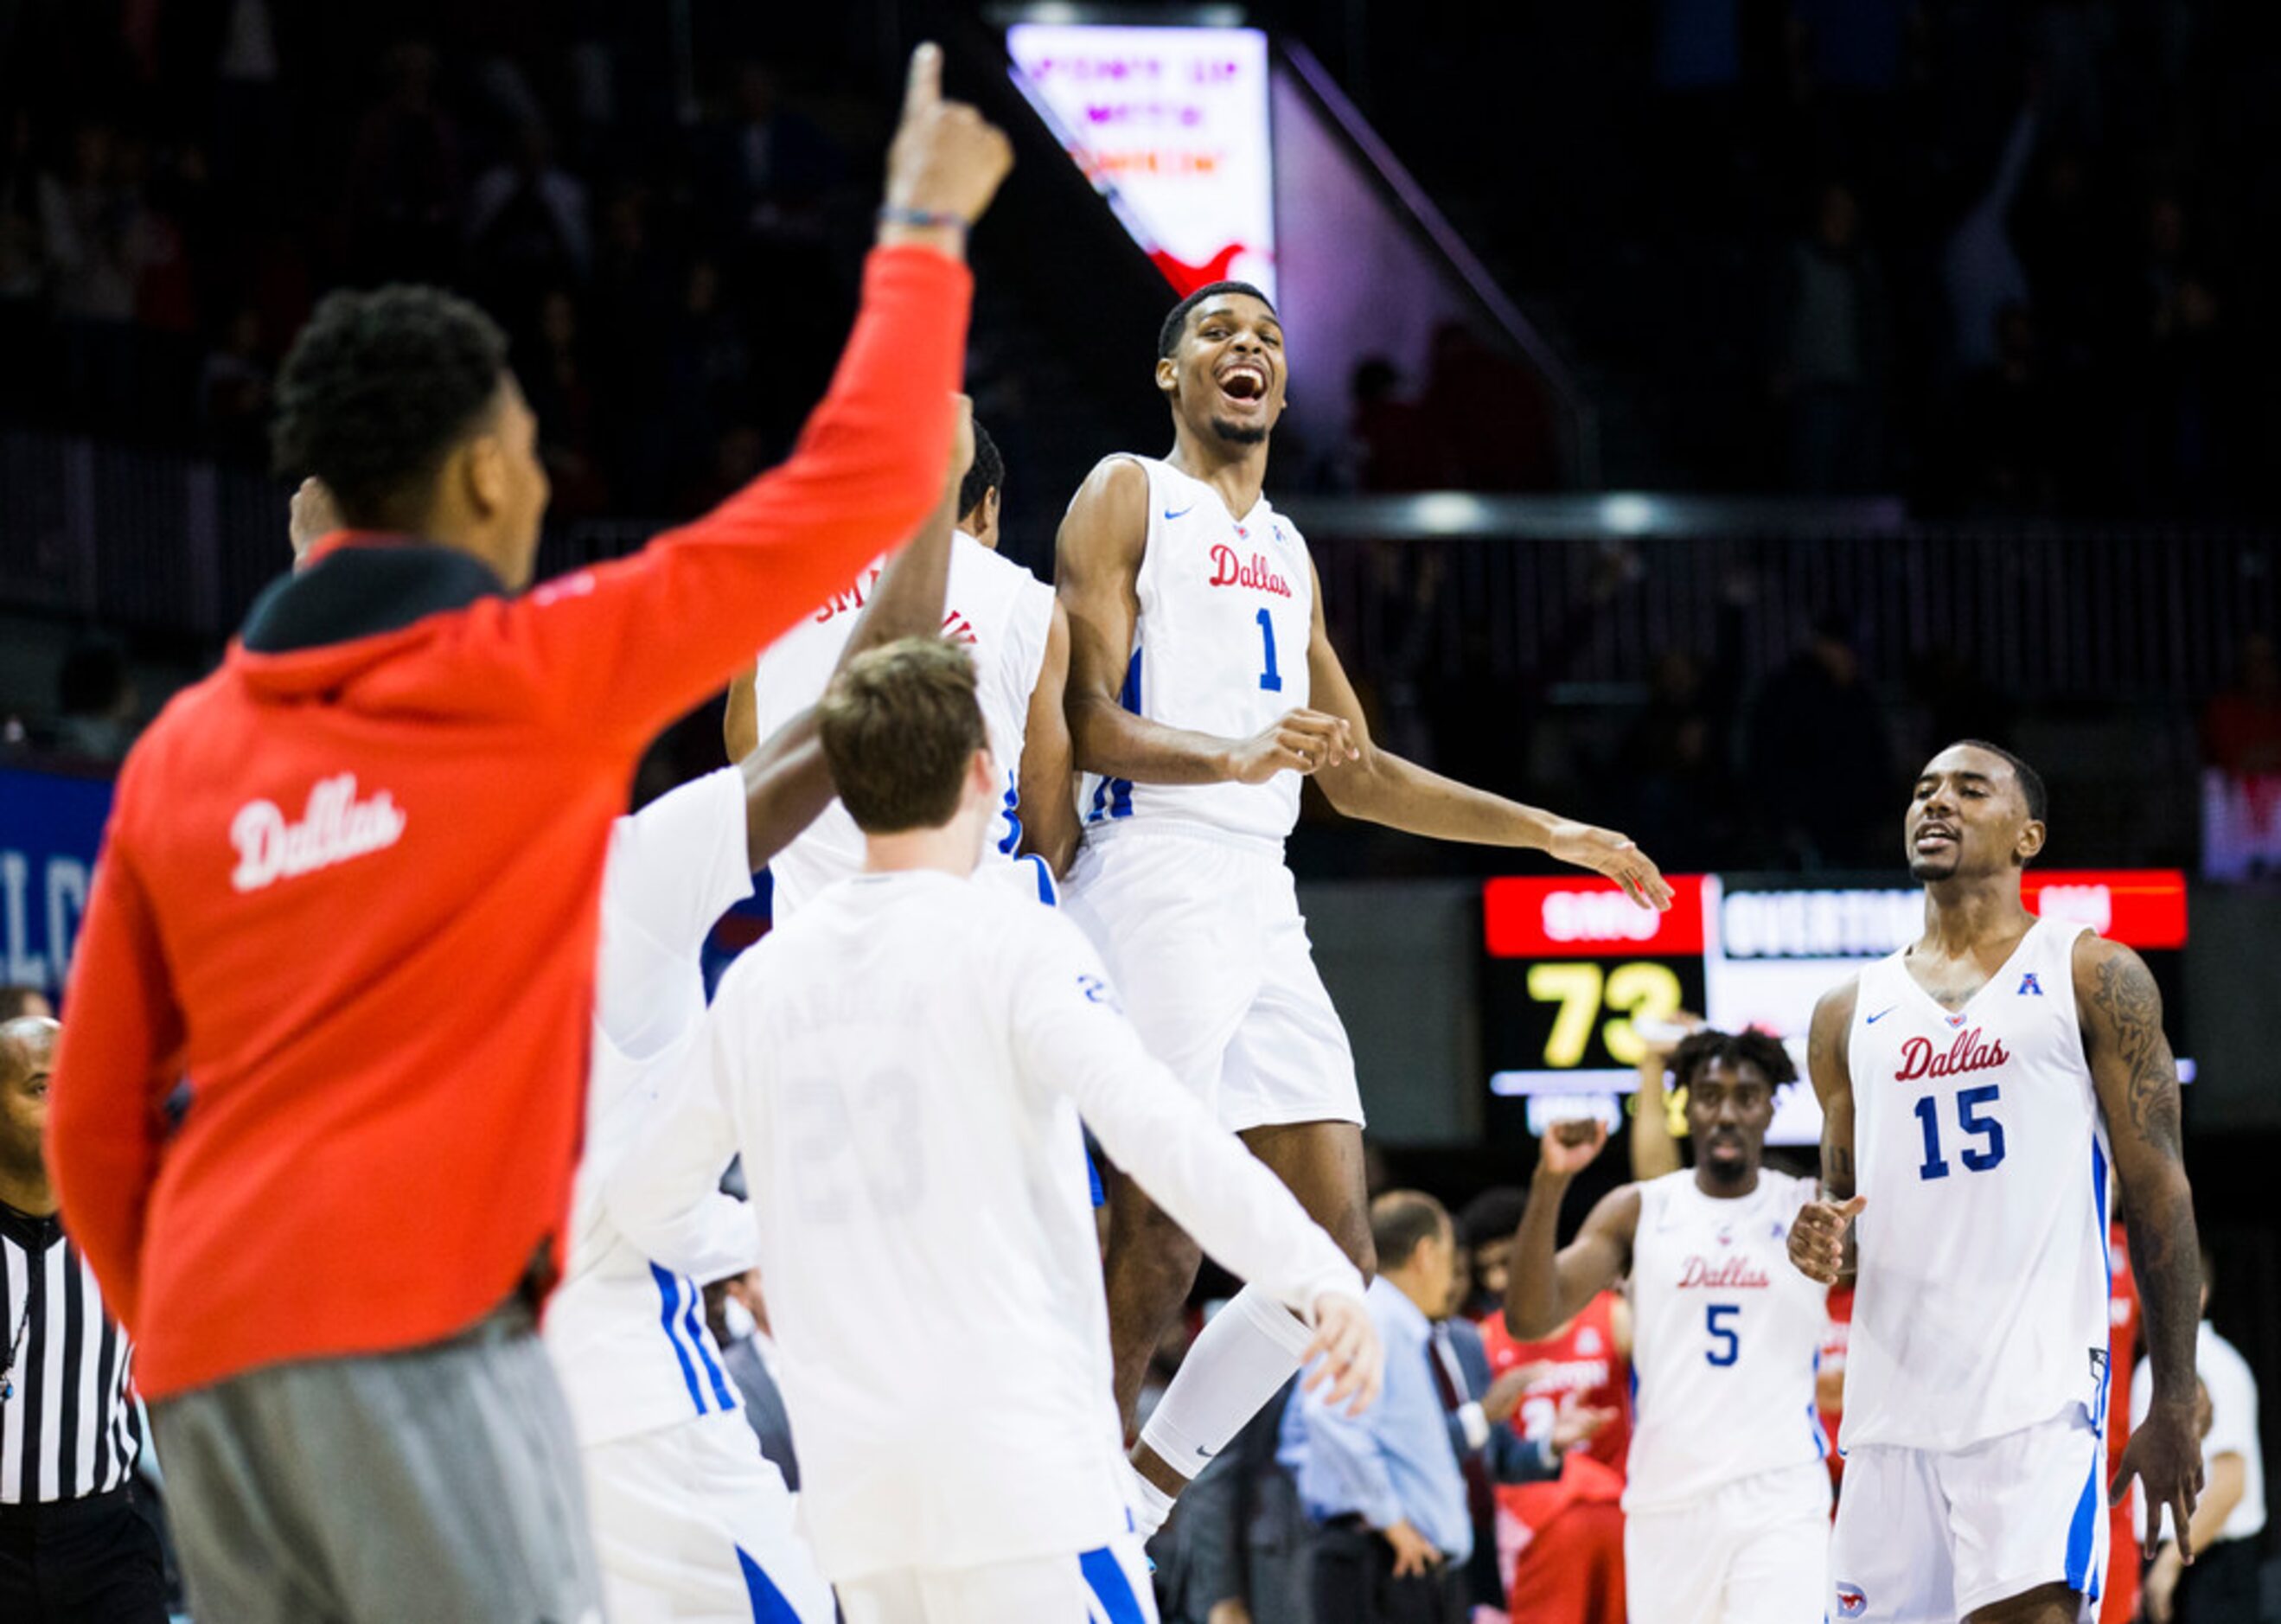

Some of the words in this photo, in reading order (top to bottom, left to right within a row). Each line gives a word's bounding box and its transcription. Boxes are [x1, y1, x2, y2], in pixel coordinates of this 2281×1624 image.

[1209, 543, 1291, 598] Dallas
[1256, 607, 1281, 693] 1
[230, 772, 406, 892] Dallas
[1527, 962, 1683, 1068] 73
[1894, 1026, 2009, 1082] Dallas
[1914, 1084, 2005, 1181] 15
[1677, 1254, 1770, 1288] Dallas
[1705, 1304, 1740, 1367] 5
